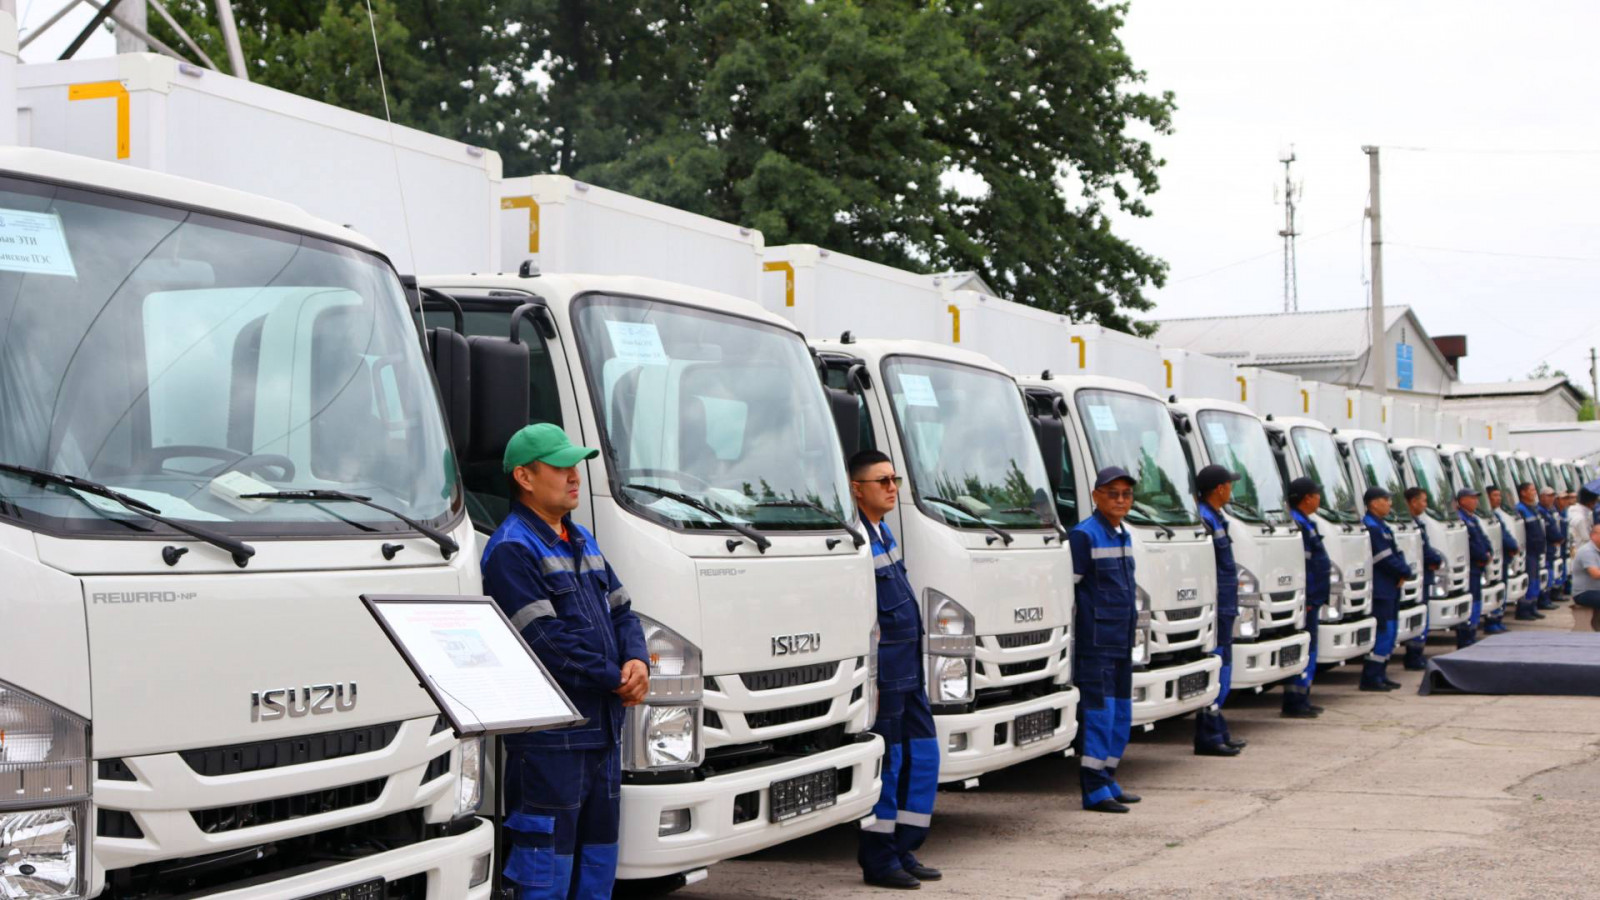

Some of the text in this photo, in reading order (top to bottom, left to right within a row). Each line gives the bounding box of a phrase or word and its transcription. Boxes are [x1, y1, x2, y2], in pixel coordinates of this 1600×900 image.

[1014, 607, 1044, 623] ISUZU
[771, 632, 821, 657] ISUZU
[250, 680, 358, 724] ISUZU
